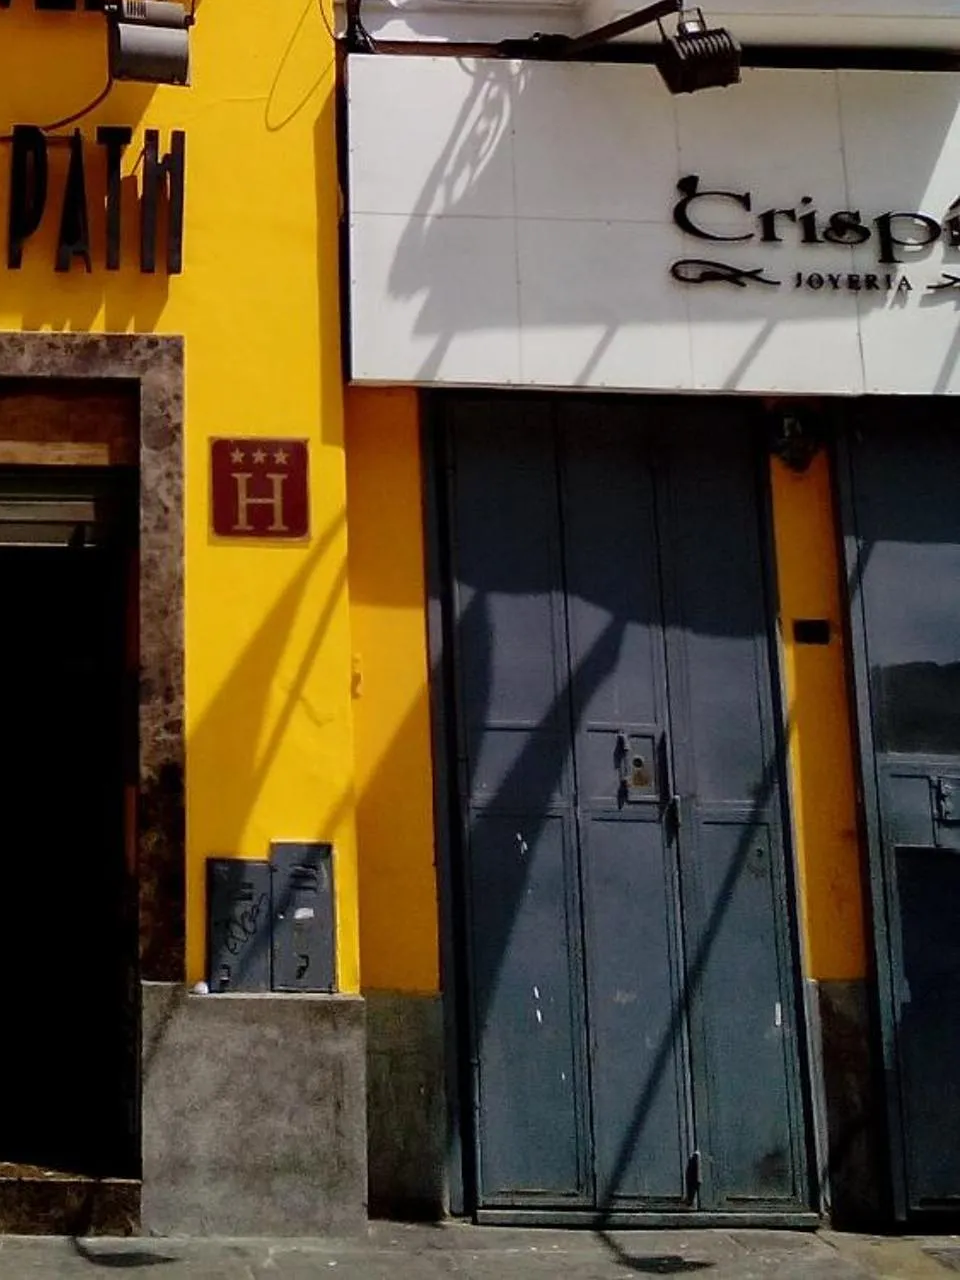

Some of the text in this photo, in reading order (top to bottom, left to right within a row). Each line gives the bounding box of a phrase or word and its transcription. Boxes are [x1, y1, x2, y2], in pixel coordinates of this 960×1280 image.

[7, 123, 187, 276] PATH
[794, 272, 914, 291] JOYERIA
[230, 471, 291, 533] H
